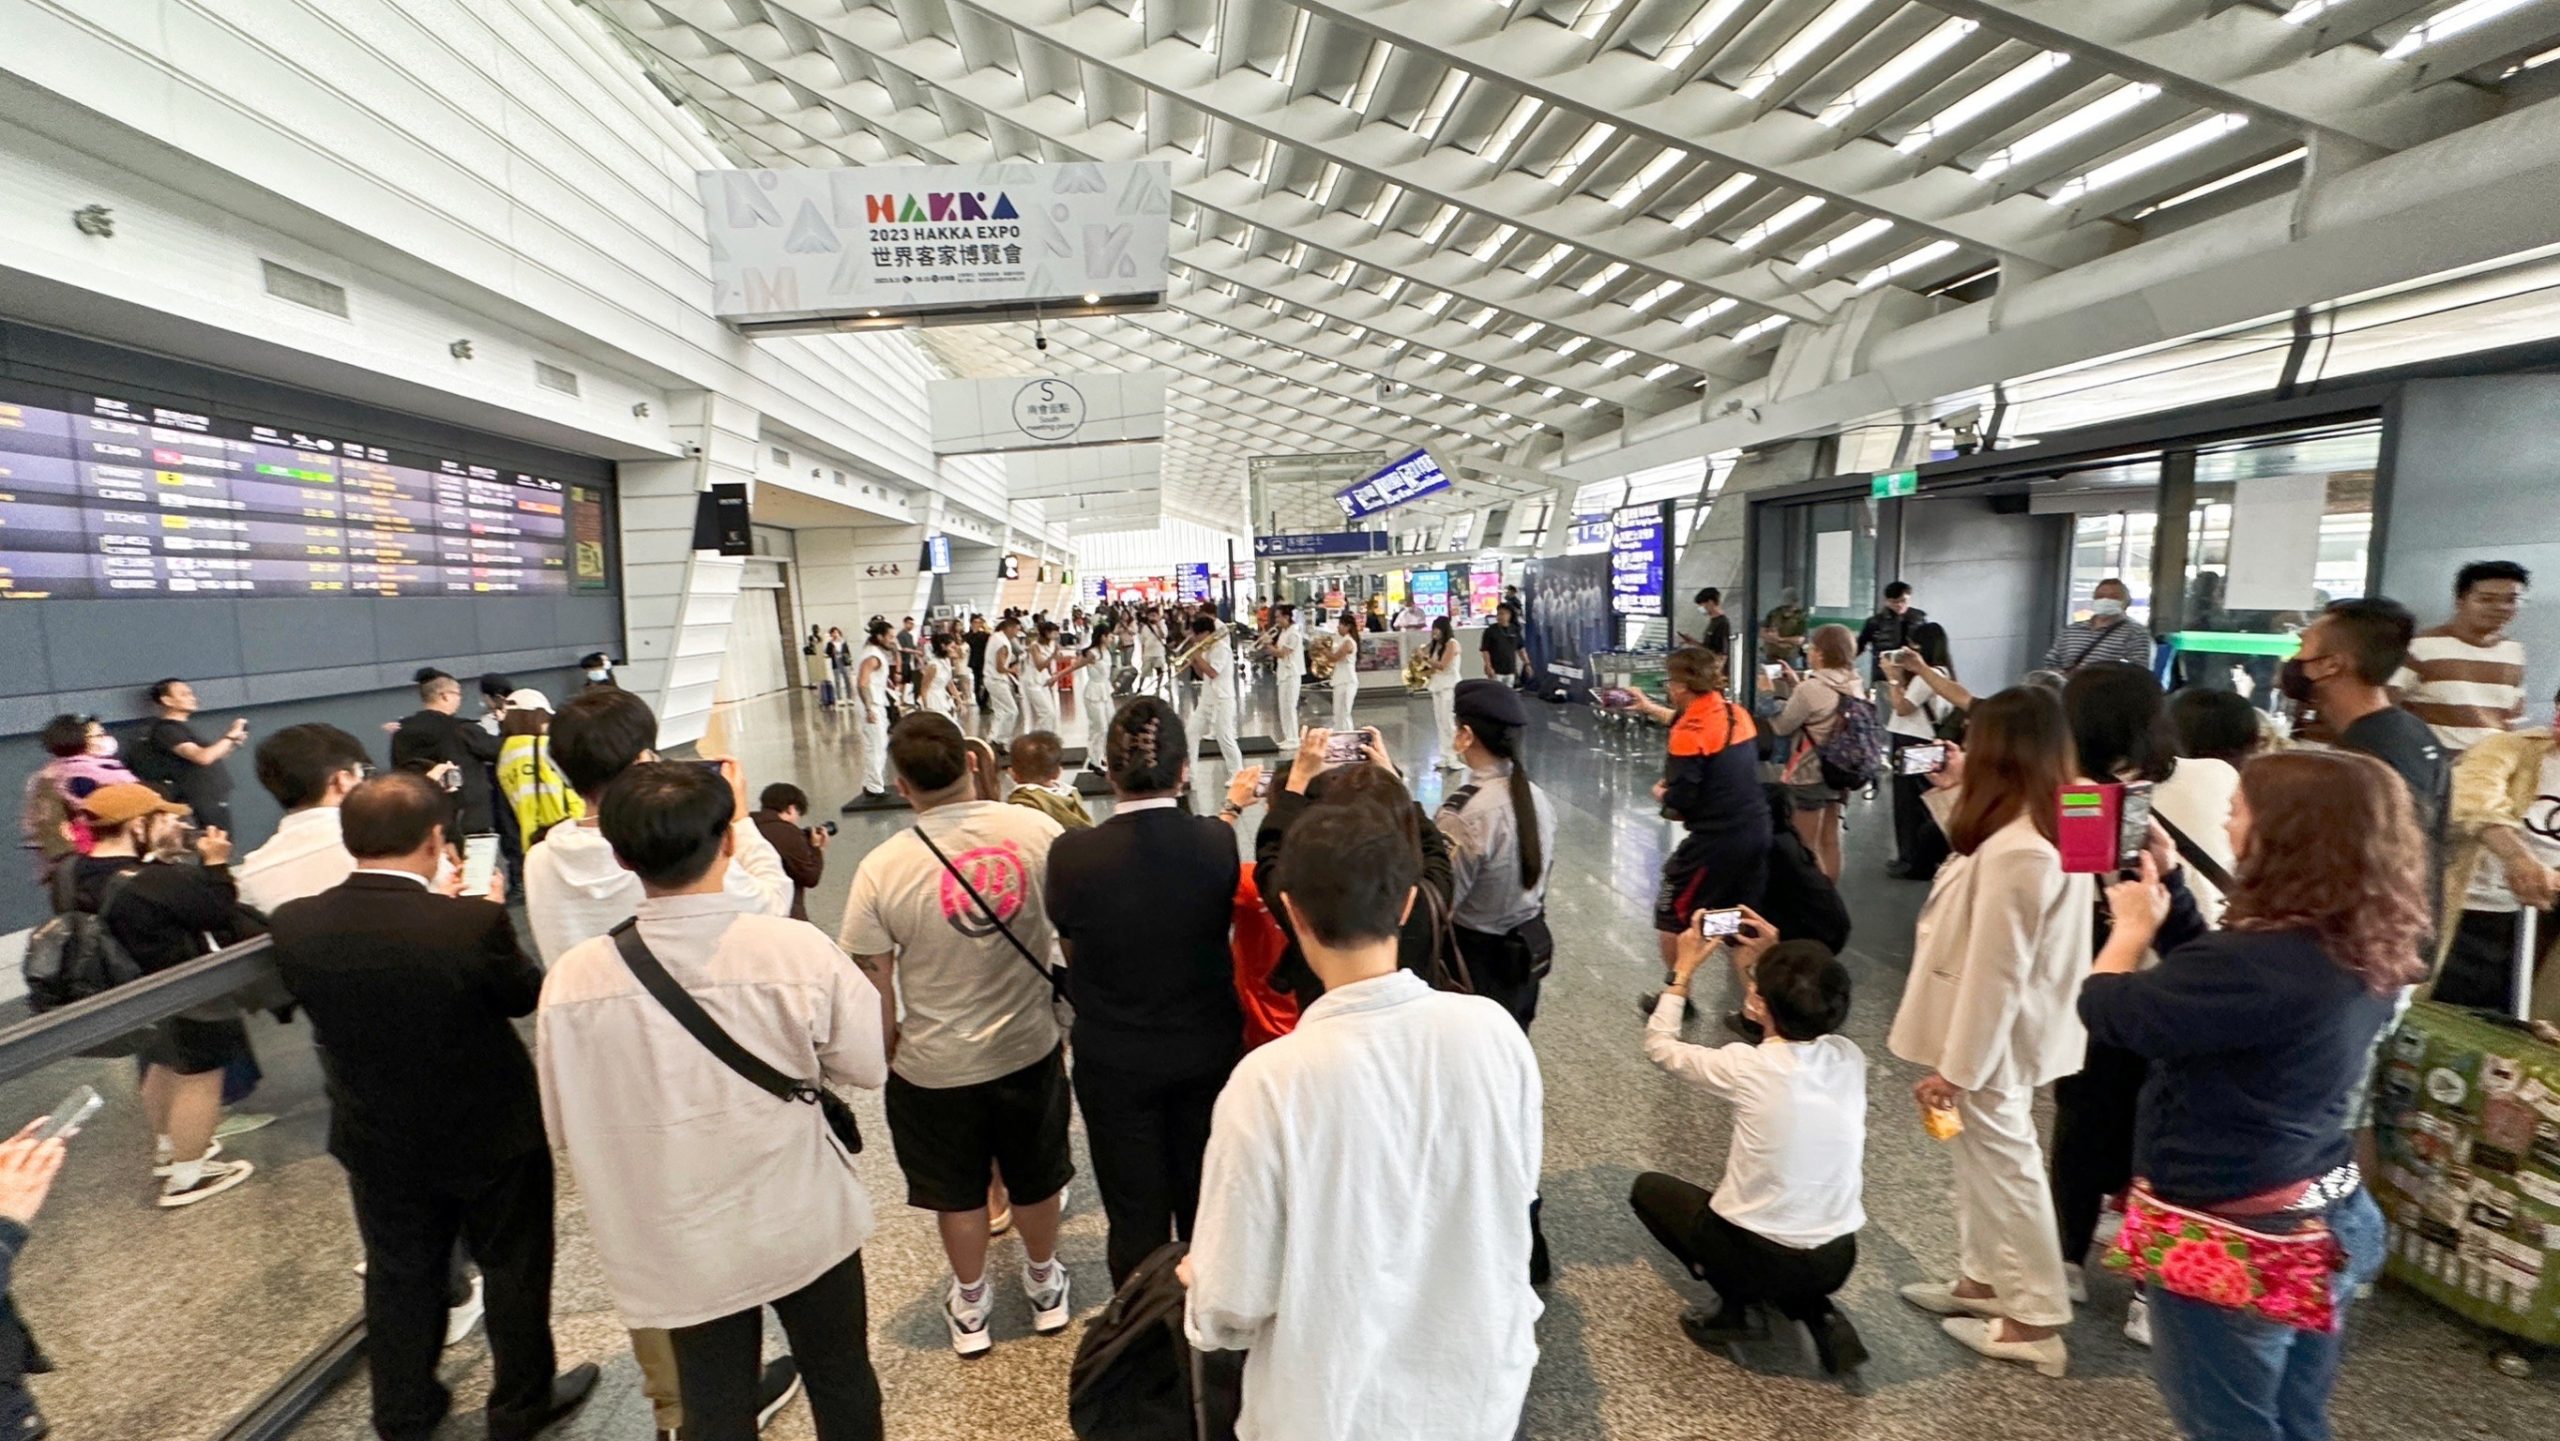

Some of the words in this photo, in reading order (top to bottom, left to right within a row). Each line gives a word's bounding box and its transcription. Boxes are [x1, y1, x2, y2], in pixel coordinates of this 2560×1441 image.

[866, 192, 1020, 223] HAKKA
[870, 229, 910, 242] 2023
[914, 227, 973, 240] HAKKA
[977, 225, 1020, 239] EXPO
[872, 243, 1022, 268] 世界客家博覽會
[1040, 381, 1055, 402] S
